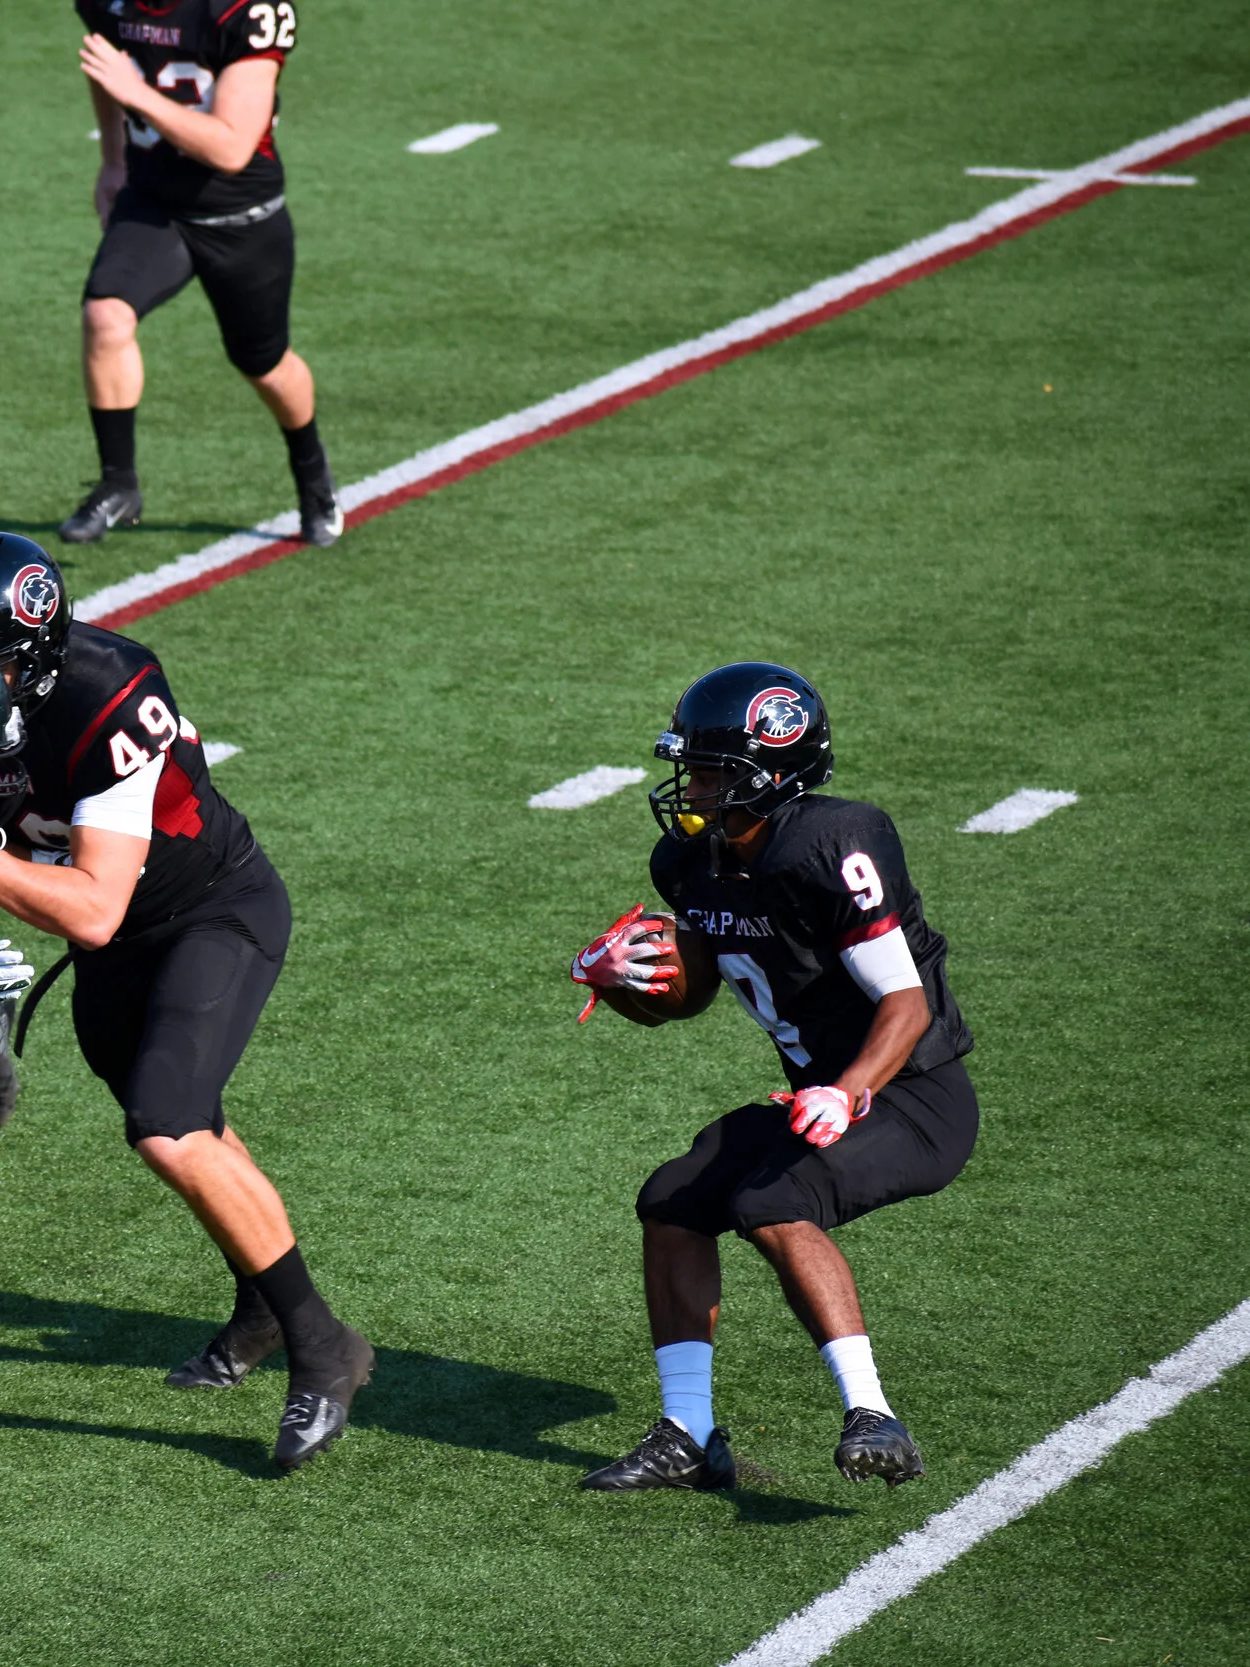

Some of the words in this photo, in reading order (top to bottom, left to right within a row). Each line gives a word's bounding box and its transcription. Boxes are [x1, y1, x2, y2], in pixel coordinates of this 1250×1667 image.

[117, 22, 181, 46] CHAPMAN
[250, 2, 297, 50] 32
[108, 695, 178, 778] 49
[840, 850, 884, 912] 9
[686, 908, 776, 938] CHAPMAN
